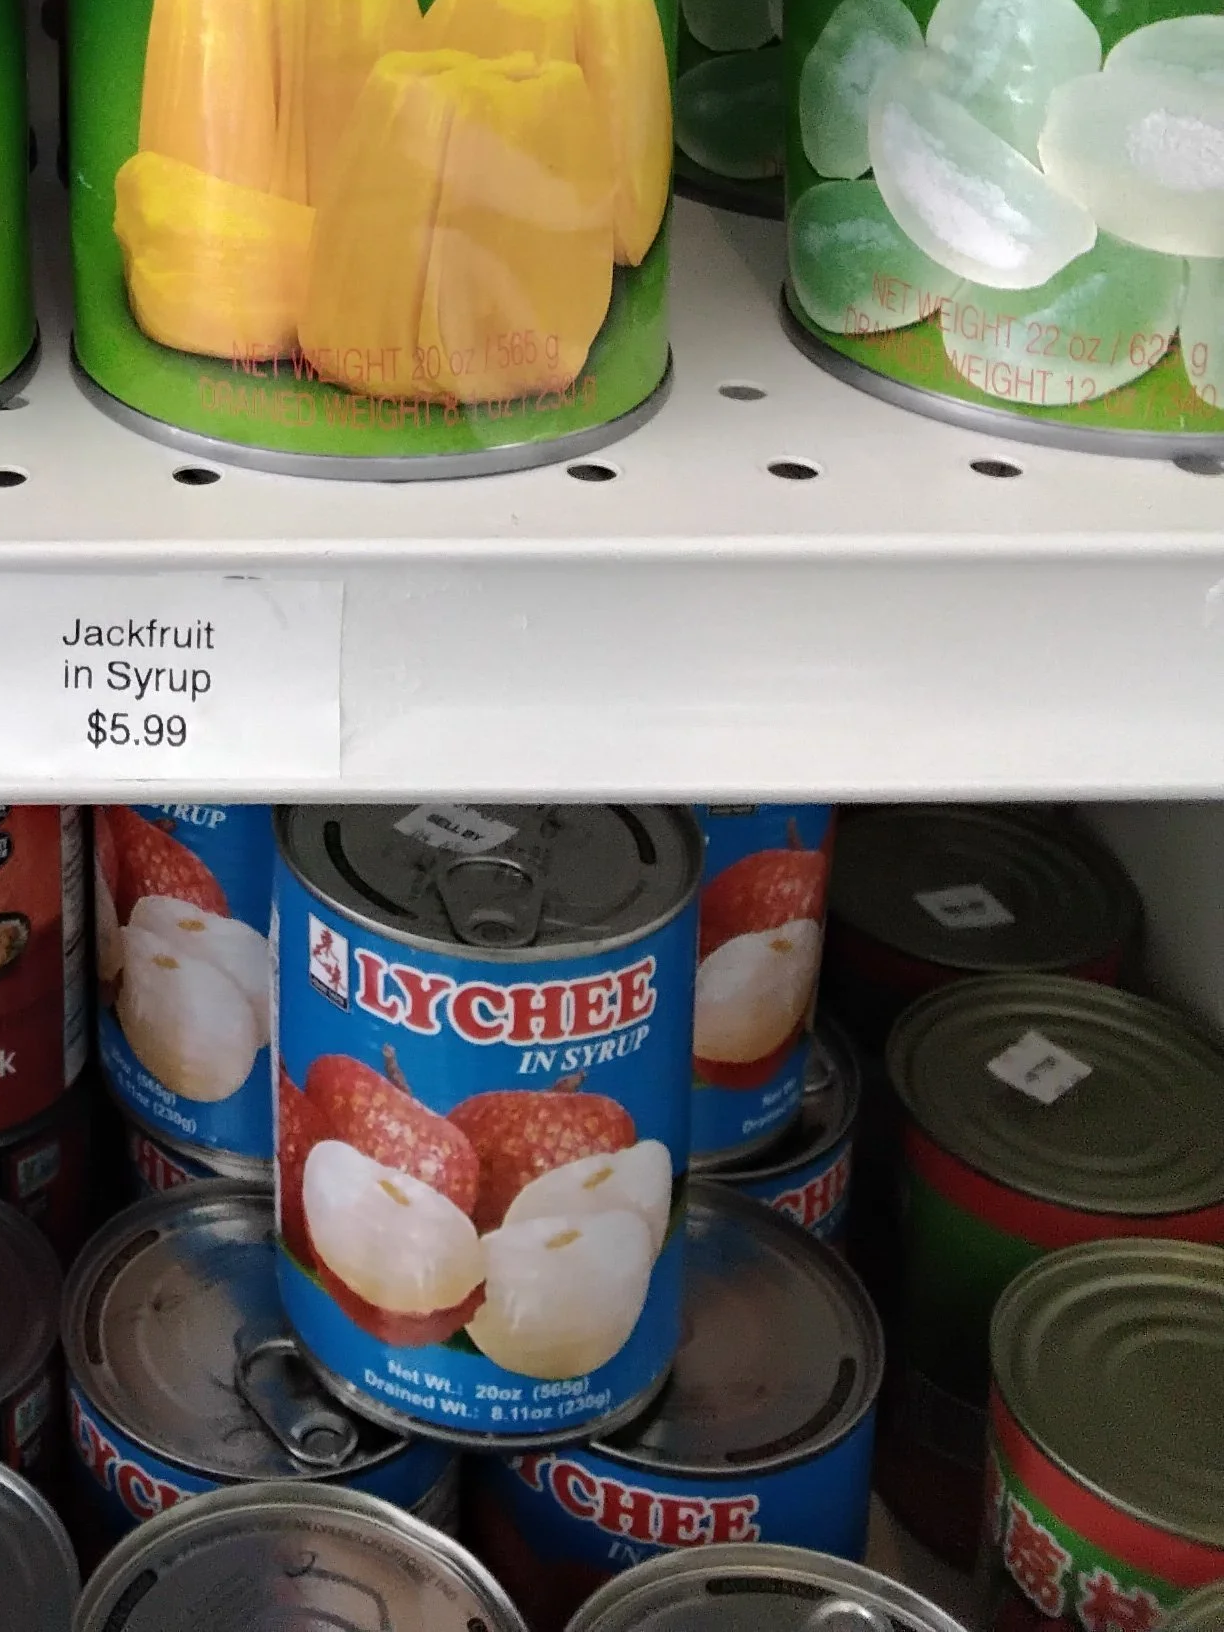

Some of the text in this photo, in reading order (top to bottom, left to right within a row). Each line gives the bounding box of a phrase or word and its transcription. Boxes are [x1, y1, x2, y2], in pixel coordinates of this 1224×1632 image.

[872, 272, 912, 316] NET
[917, 288, 1017, 349] WEIGHT
[1026, 321, 1061, 357] 22
[1068, 335, 1101, 363] oz
[1191, 341, 1209, 377] g
[232, 340, 281, 379] NET
[291, 344, 403, 385] WEIGHT
[449, 348, 476, 377] oz
[497, 330, 538, 369] 565
[545, 334, 561, 370] g
[944, 349, 1053, 405] WEIGHT
[1065, 375, 1097, 411] 12
[200, 375, 317, 428] DRAINED
[324, 392, 433, 429] WEIGHT
[62, 619, 216, 650] Jackfruit
[63, 659, 212, 702] in Syrup
[87, 708, 188, 749] $5.99
[354, 946, 657, 1047] LYCHEE
[517, 1025, 652, 1076] IN SYRUP
[363, 1368, 436, 1410] Drained
[386, 1359, 422, 1386] Net
[474, 1384, 522, 1401] 20oz
